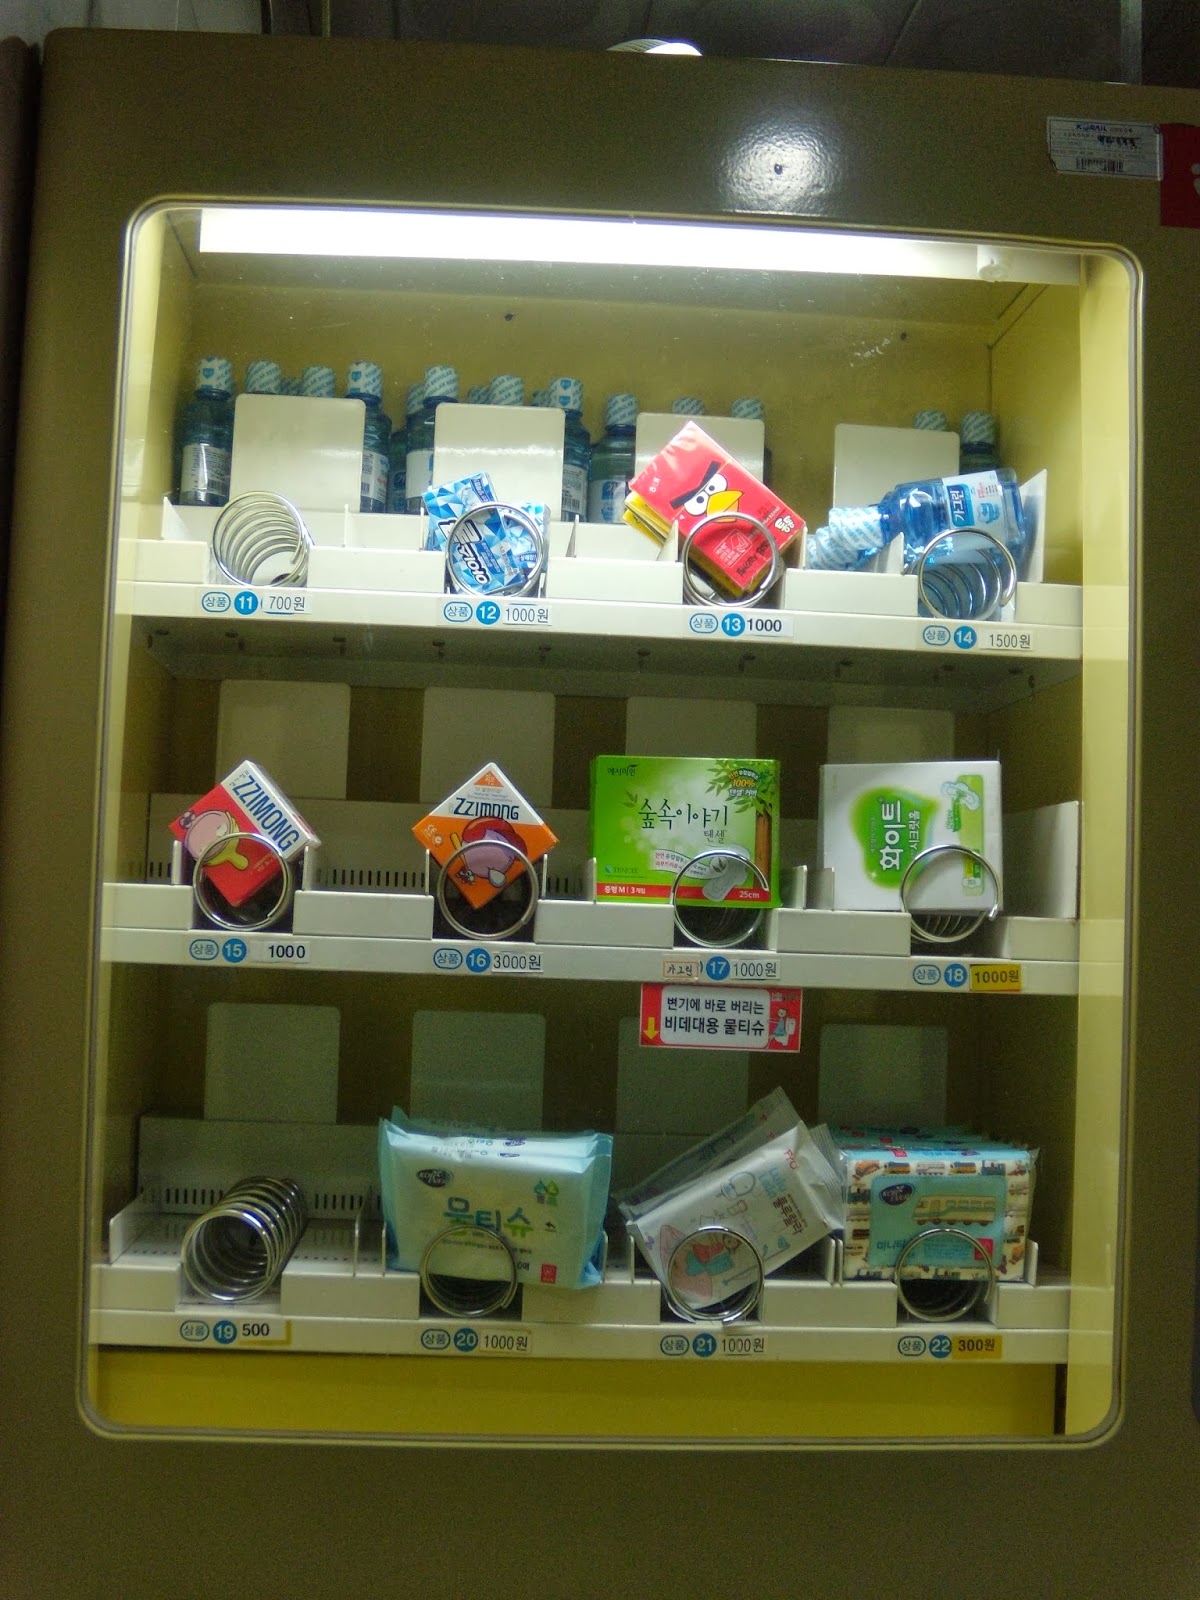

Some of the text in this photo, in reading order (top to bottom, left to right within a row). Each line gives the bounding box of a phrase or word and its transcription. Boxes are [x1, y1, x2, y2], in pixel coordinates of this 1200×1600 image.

[949, 489, 965, 522] 가그린
[204, 594, 306, 612] 상품 11 700원
[447, 605, 549, 624] 상품 12 1000원
[692, 615, 783, 634] 상품 13 1000
[925, 628, 1032, 649] 상품 14 1500원
[732, 779, 756, 788] 100%
[231, 774, 300, 852] ZZIMONG
[638, 798, 729, 831] 숲속이야기
[879, 799, 907, 871] 화이트
[738, 890, 760, 899] 25cm
[192, 943, 306, 959] 상품 15 1000
[436, 953, 541, 970] 상품 16 3000원
[666, 961, 777, 978] 가그린 17 1000원
[916, 968, 1020, 984] 상품 18 1000원
[667, 997, 765, 1015] 변기에 바로 버리는
[664, 1016, 766, 1037] 비데대용 물티슈
[183, 1324, 270, 1338] 상품 19 500
[424, 1332, 529, 1351] 상품 20 1000원
[664, 1337, 765, 1353] 상품 21 1000원
[901, 1339, 995, 1352] 상품 22 300원
